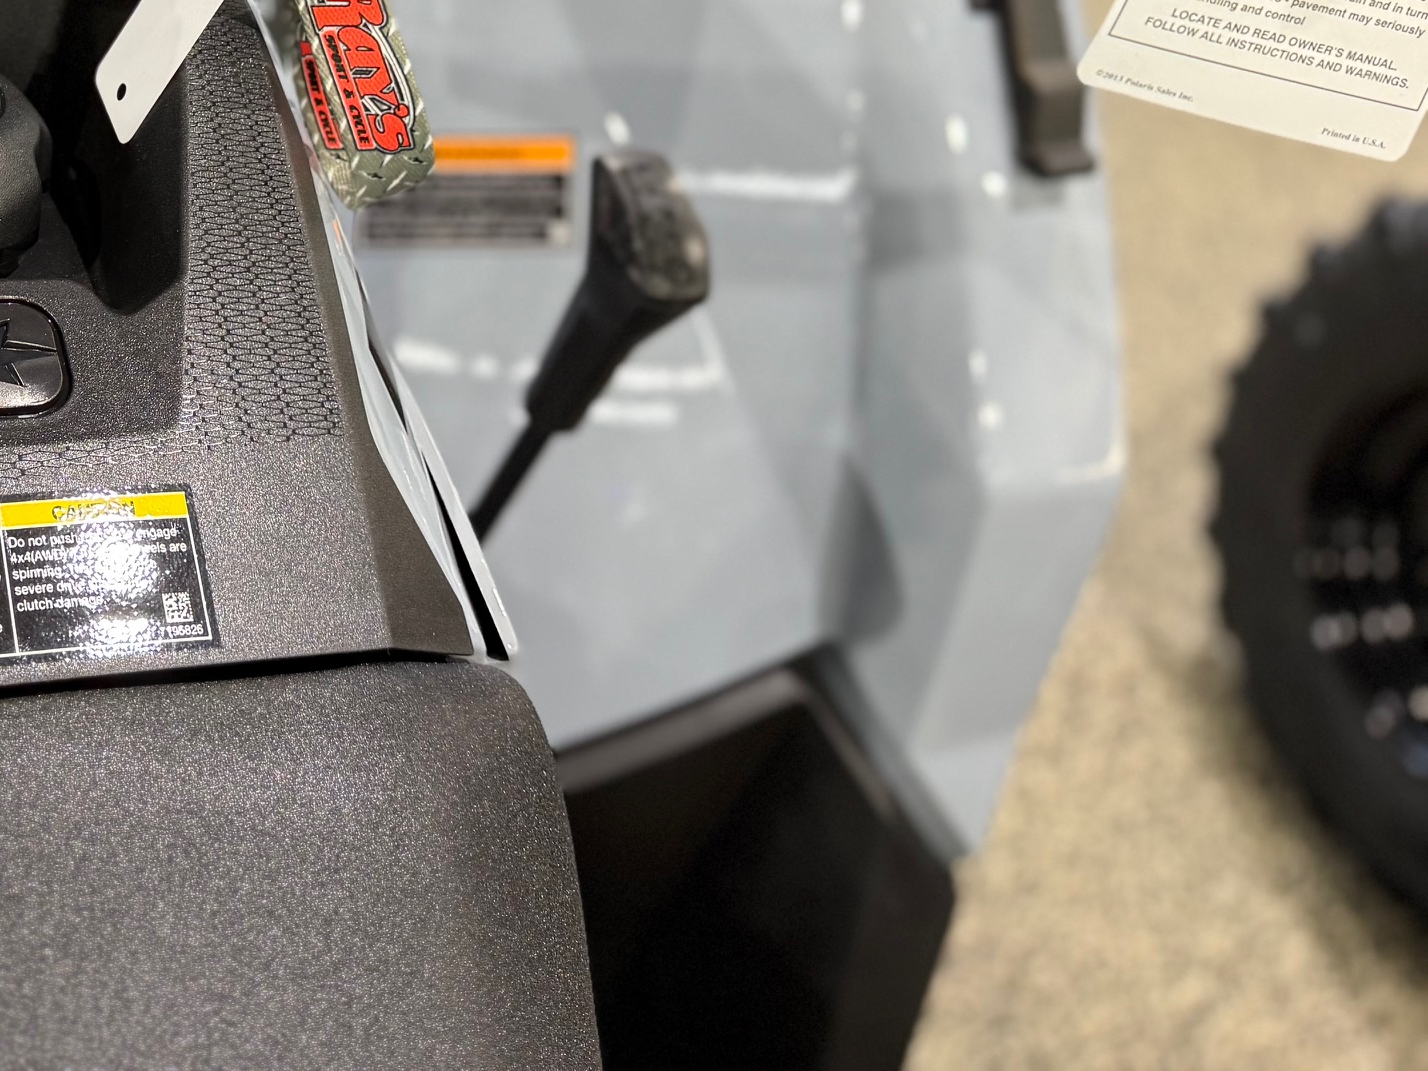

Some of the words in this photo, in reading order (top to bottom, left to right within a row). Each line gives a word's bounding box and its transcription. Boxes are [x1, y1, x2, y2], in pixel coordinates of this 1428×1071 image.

[1240, 4, 1264, 15] and
[1265, 10, 1306, 26] control
[1368, 0, 1392, 11] and
[1392, 2, 1404, 14] in
[1290, 0, 1347, 18] pavement
[1348, 12, 1373, 26] may
[1374, 18, 1426, 39] seriously
[1171, 8, 1222, 29] LOCATE
[1222, 21, 1250, 35] AND
[1252, 28, 1286, 44] READ
[1288, 37, 1345, 58] OWNER'S
[1345, 50, 1397, 71] MANUAL.
[1144, 16, 1199, 37] FOLLOW
[1199, 31, 1223, 45] ALL
[1226, 37, 1315, 66] INSTRUCTIONS
[1315, 59, 1342, 72] AND
[1345, 65, 1409, 89] WARNINGS.
[1155, 86, 1177, 97] Sales
[1321, 127, 1352, 141] Printed
[1352, 134, 1361, 143] in
[8, 536, 25, 549] Do
[28, 534, 47, 547] not
[50, 532, 77, 547] push
[169, 542, 187, 553] are
[14, 582, 54, 596] severe
[17, 597, 53, 613] clutch
